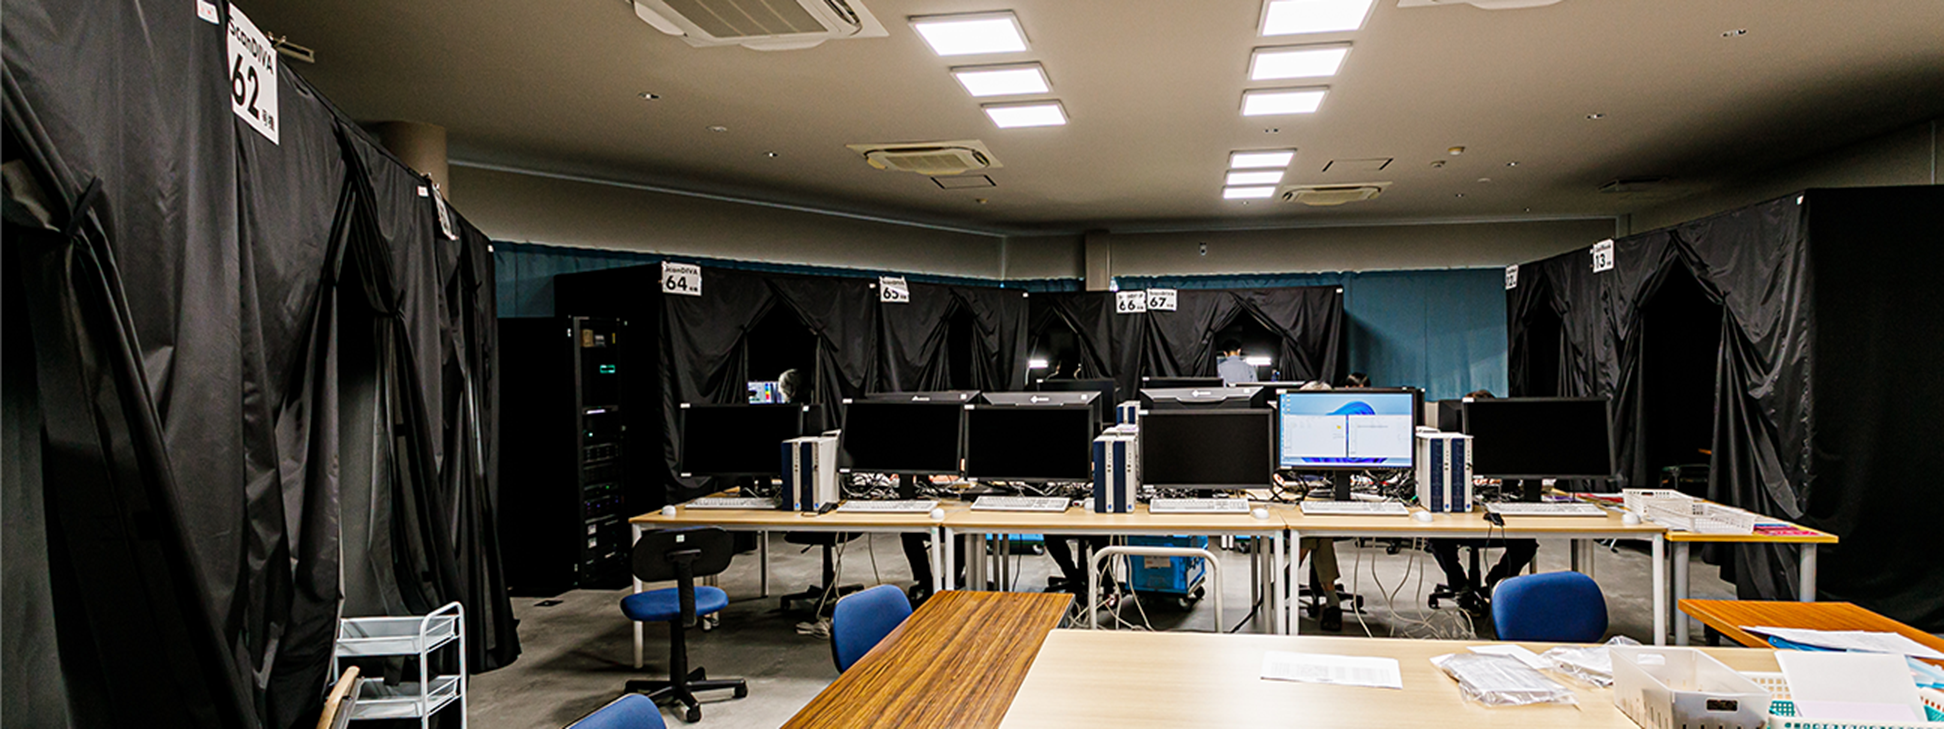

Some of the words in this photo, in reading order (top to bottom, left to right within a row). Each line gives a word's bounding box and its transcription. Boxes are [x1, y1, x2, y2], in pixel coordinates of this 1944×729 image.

[232, 53, 260, 120] 62
[1595, 253, 1606, 269] 13
[666, 275, 687, 291] 64
[1150, 297, 1166, 307] 67
